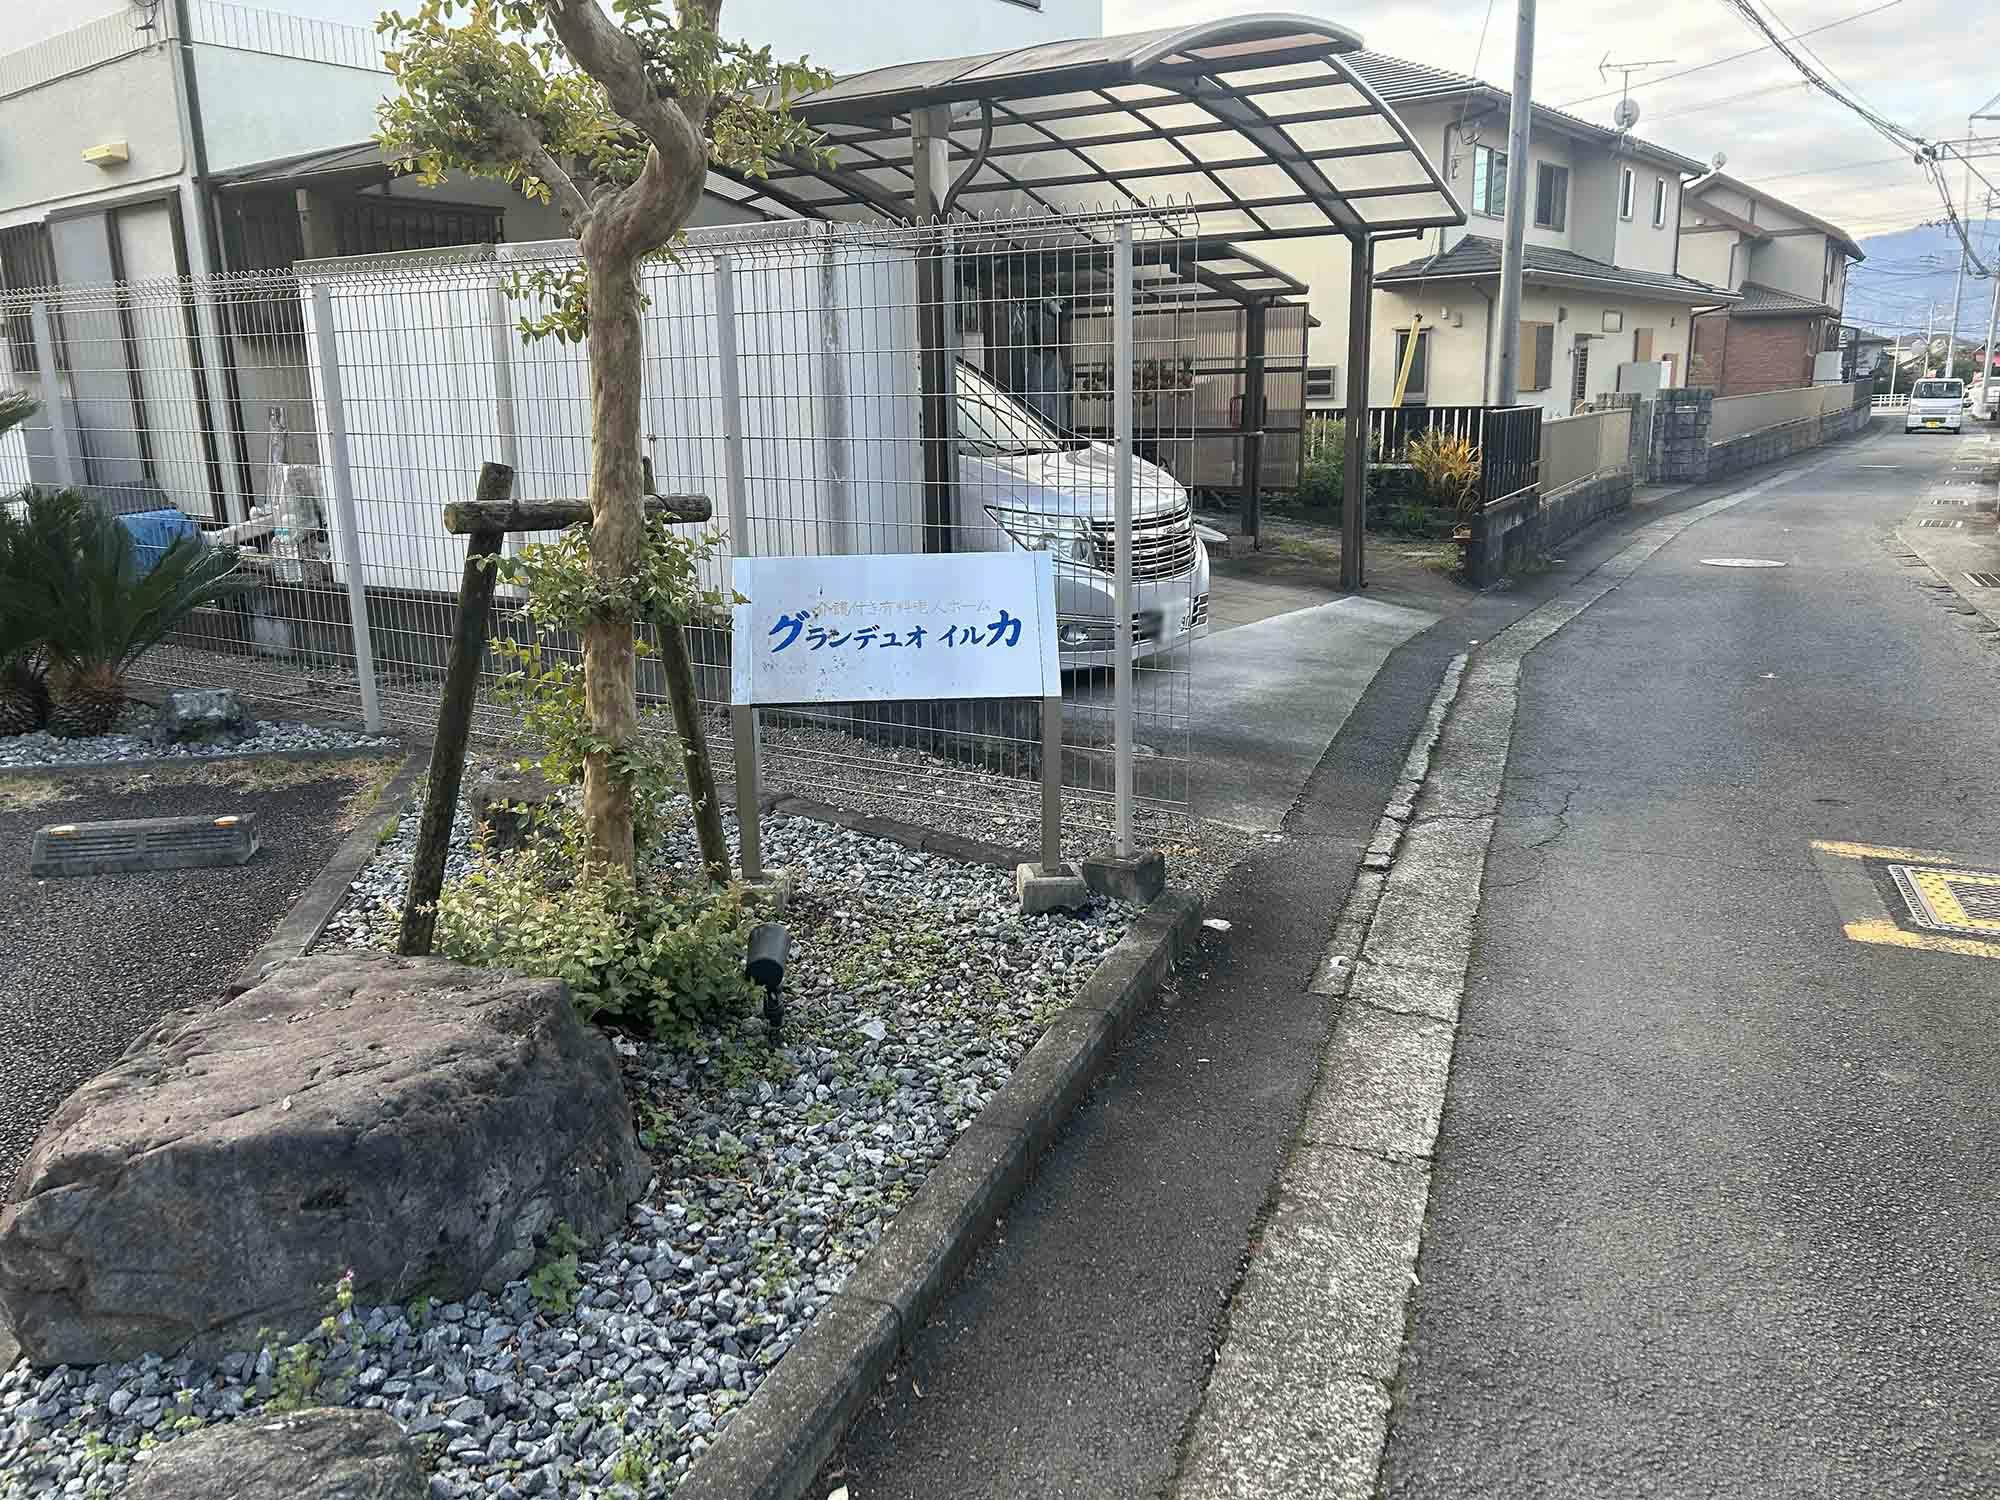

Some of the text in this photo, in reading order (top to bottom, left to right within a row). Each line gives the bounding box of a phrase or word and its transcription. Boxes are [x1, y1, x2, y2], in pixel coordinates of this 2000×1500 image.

[768, 609, 1022, 653] グランデュオ イルカ
